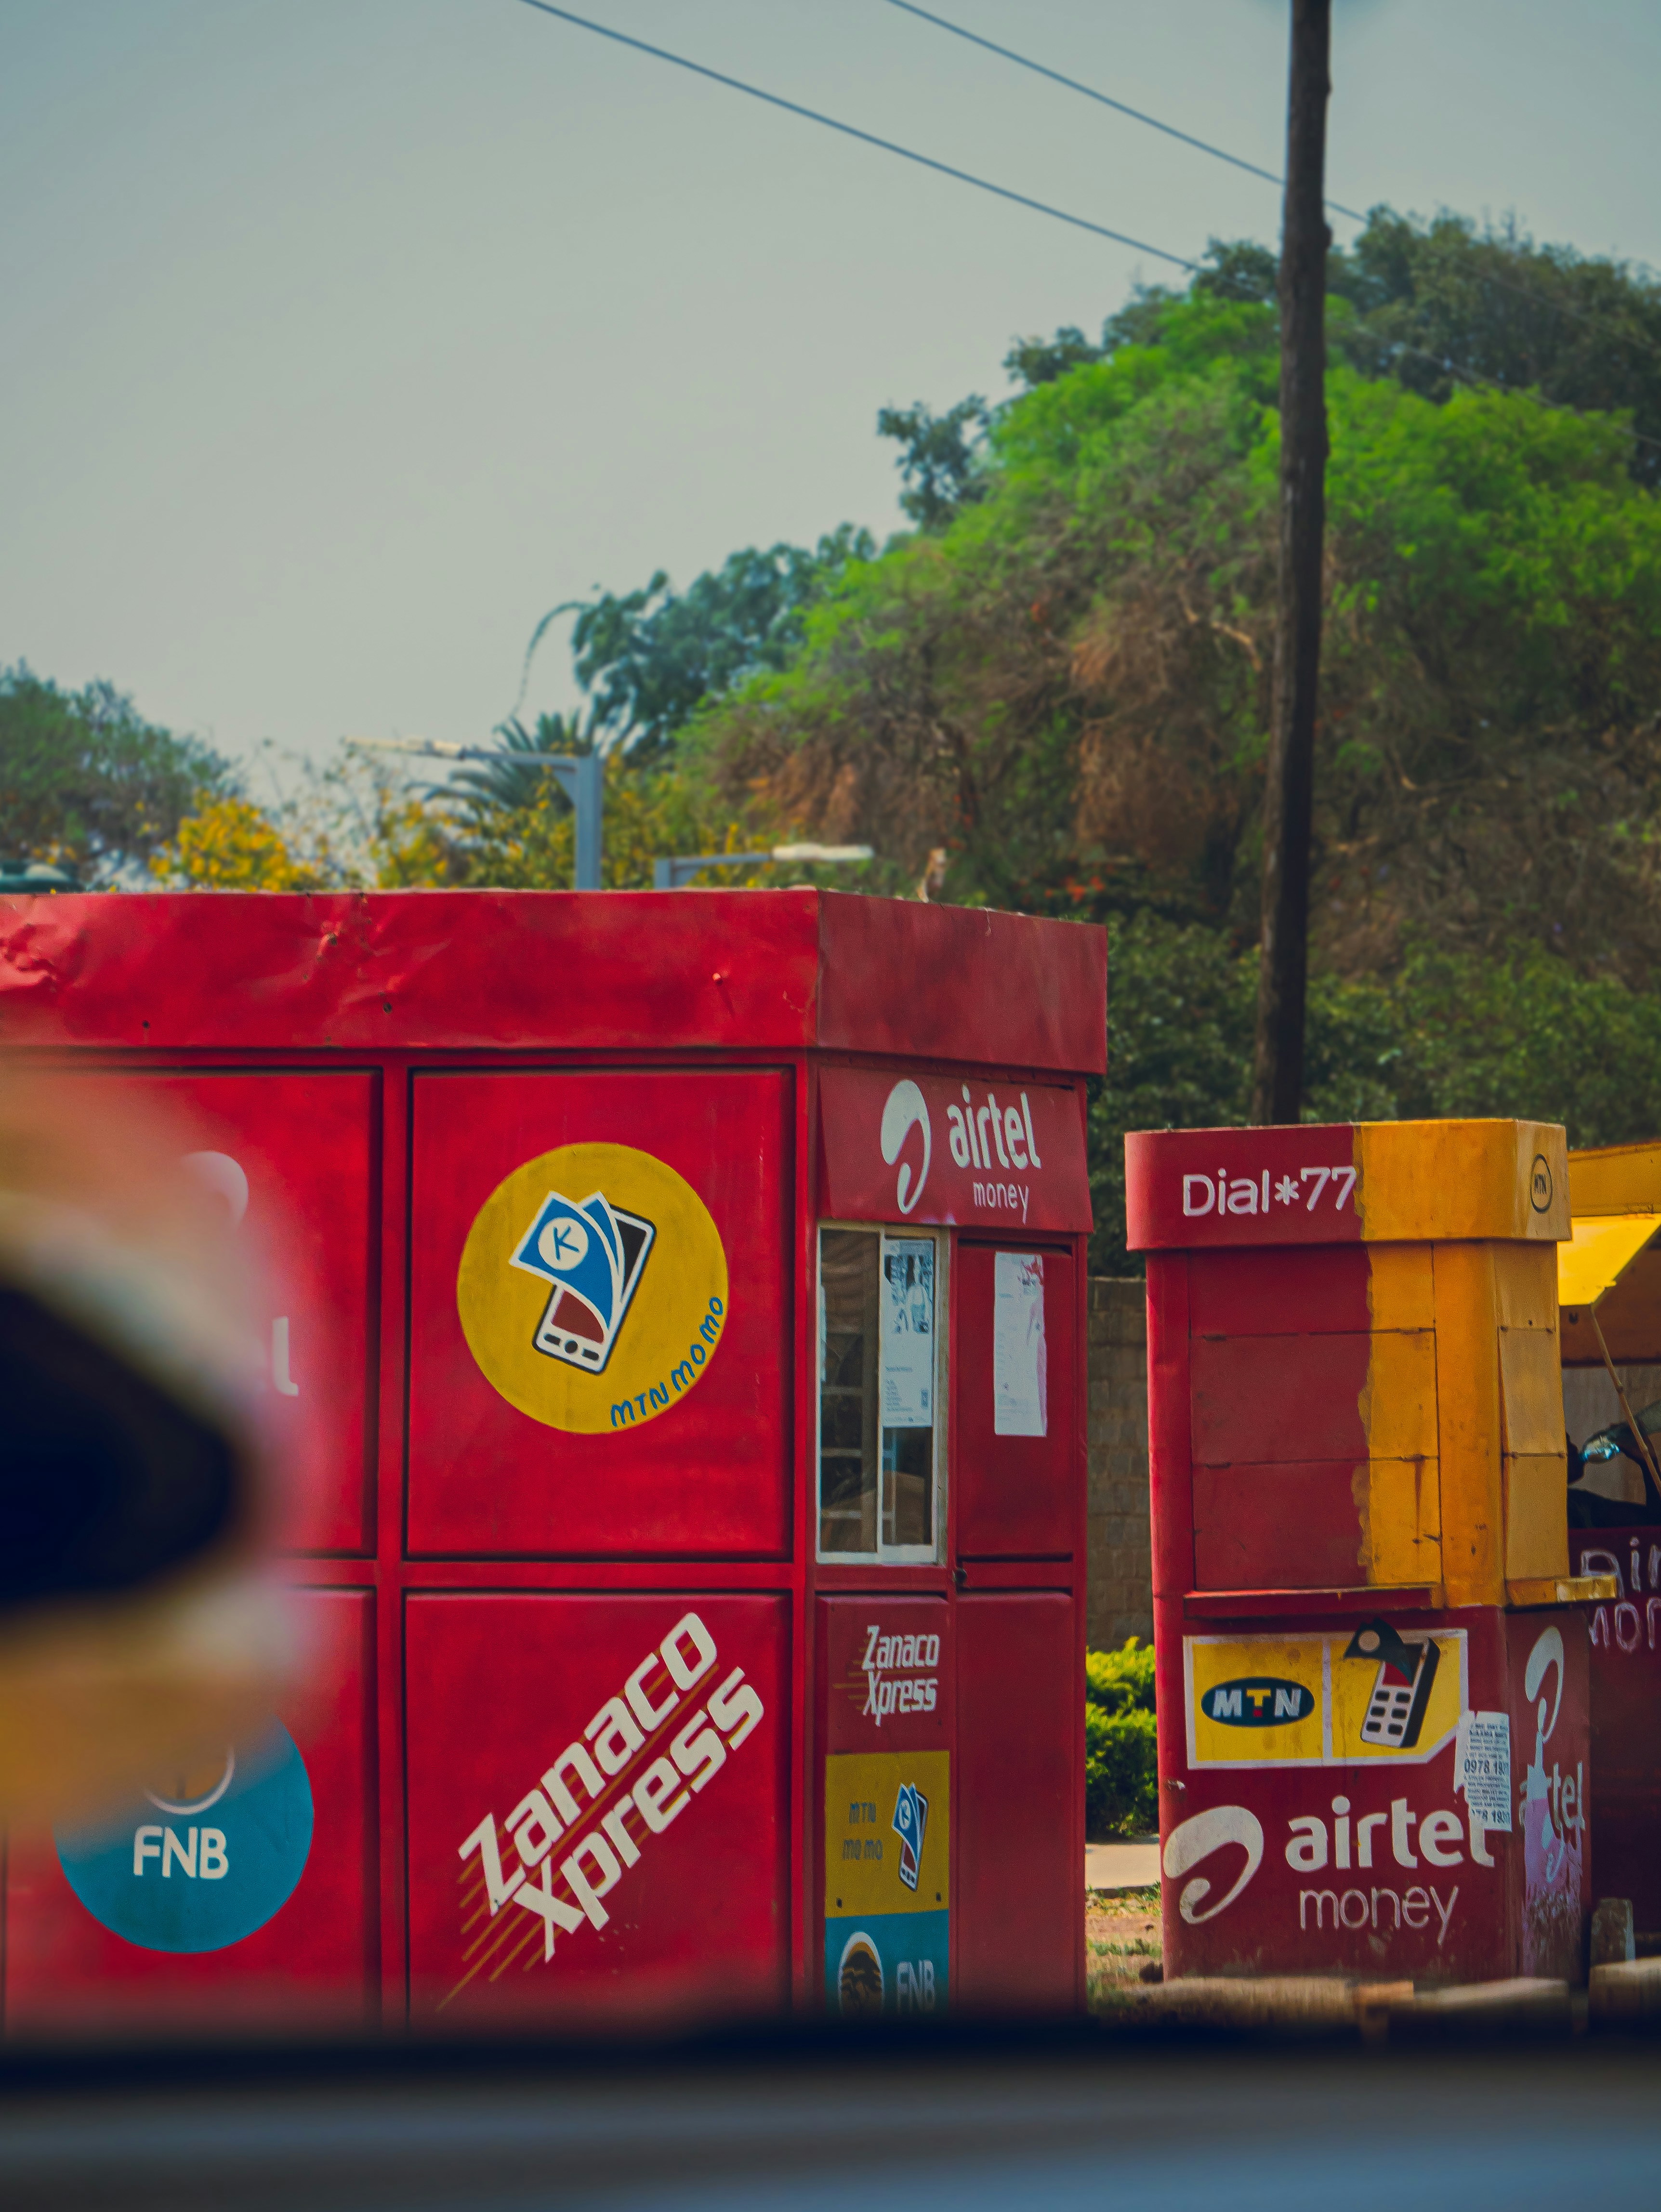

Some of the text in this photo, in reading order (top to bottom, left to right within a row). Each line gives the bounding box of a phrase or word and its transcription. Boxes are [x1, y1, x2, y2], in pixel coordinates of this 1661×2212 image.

[947, 1085, 1041, 1169] airtel
[973, 1181, 1029, 1224] money
[610, 1382, 670, 1427] MTN
[862, 1625, 940, 1670] Zanaco
[862, 1670, 938, 1727] Xpress
[1212, 1688, 1302, 1718] MTN
[458, 1612, 718, 1917] Zanaco
[1464, 1758, 1490, 1774] 0978
[513, 1666, 765, 1963] Xpress
[1285, 1795, 1494, 1872] airtel
[133, 1825, 229, 1879] FNB
[1300, 1885, 1459, 1945] money
[896, 1959, 935, 2013] FNB
